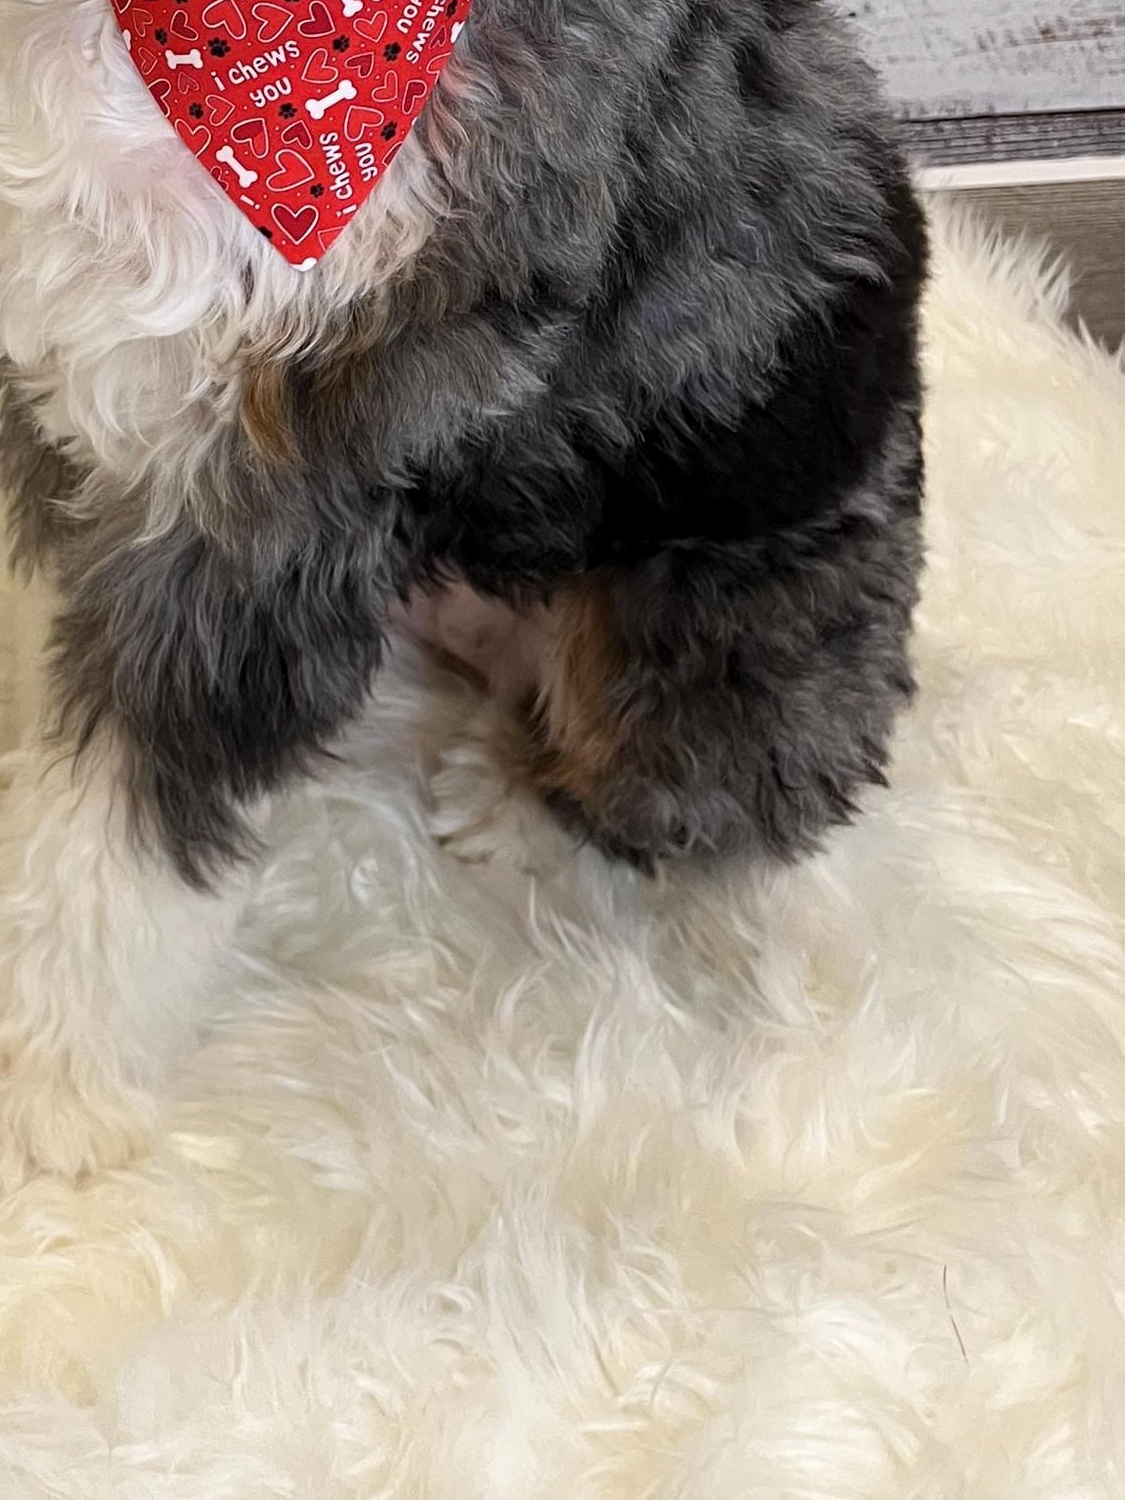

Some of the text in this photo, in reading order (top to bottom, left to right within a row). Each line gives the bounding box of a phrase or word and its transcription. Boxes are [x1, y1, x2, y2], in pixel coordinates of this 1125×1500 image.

[210, 40, 300, 91] i chews
[249, 77, 292, 107] you
[319, 132, 357, 217] i chews
[355, 142, 378, 182] you
